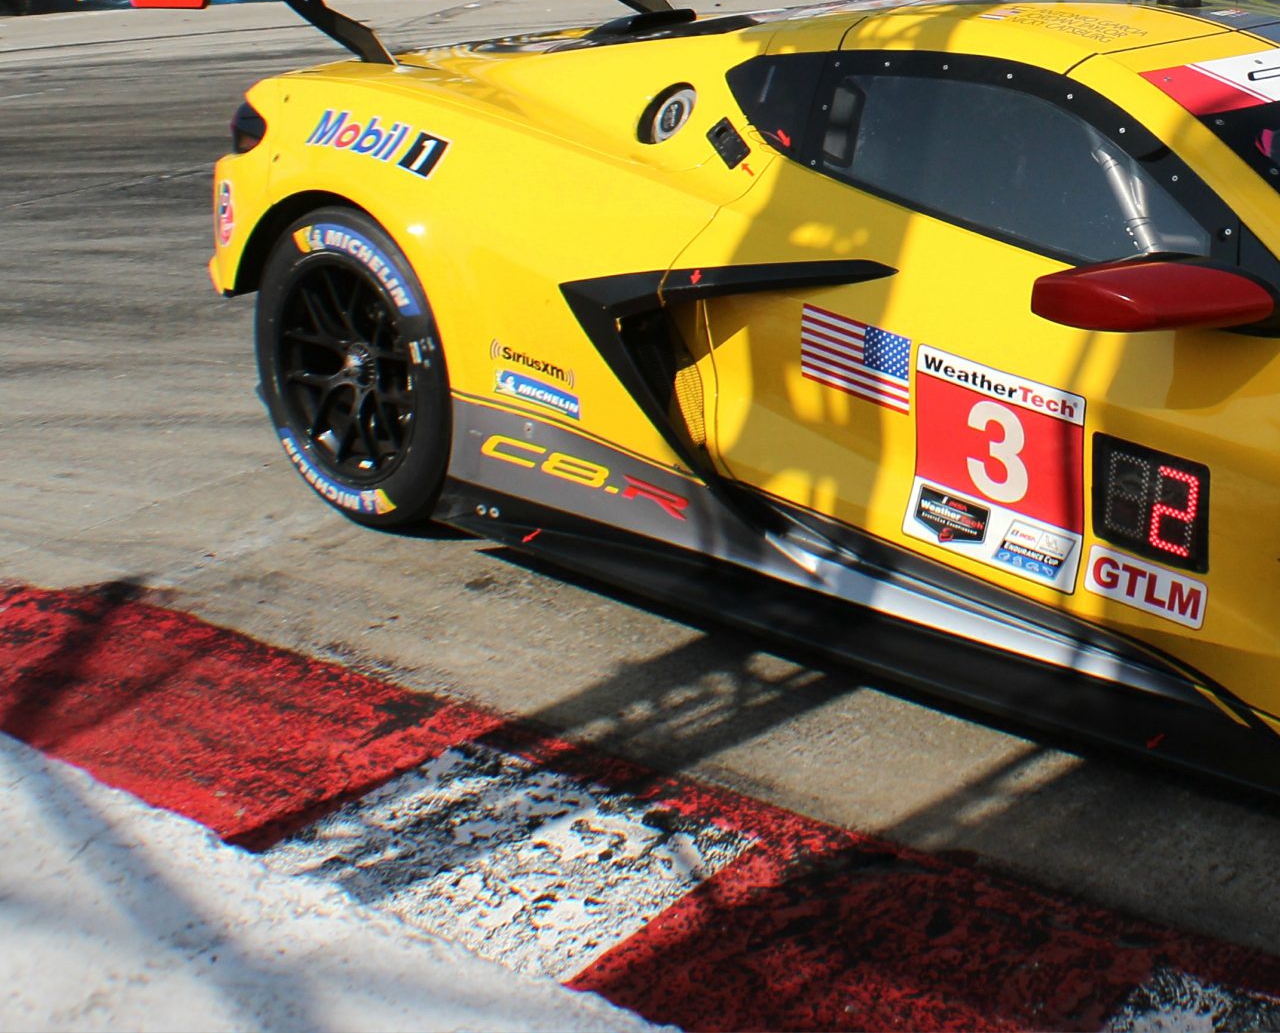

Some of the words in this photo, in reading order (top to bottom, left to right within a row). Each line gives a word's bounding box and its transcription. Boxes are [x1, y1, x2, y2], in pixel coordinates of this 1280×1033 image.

[305, 108, 409, 162] Mobil
[409, 136, 437, 173] 1
[324, 229, 411, 308] MICHELIN
[517, 383, 579, 414] MICHELIN
[923, 353, 1077, 419] WeatherTech
[281, 437, 361, 511] MICHELIN
[480, 434, 690, 520] C8.R
[966, 400, 1030, 504] 3
[921, 498, 985, 530] WeatherTech
[1148, 465, 1200, 559] 2
[1092, 555, 1201, 621] GTLM
